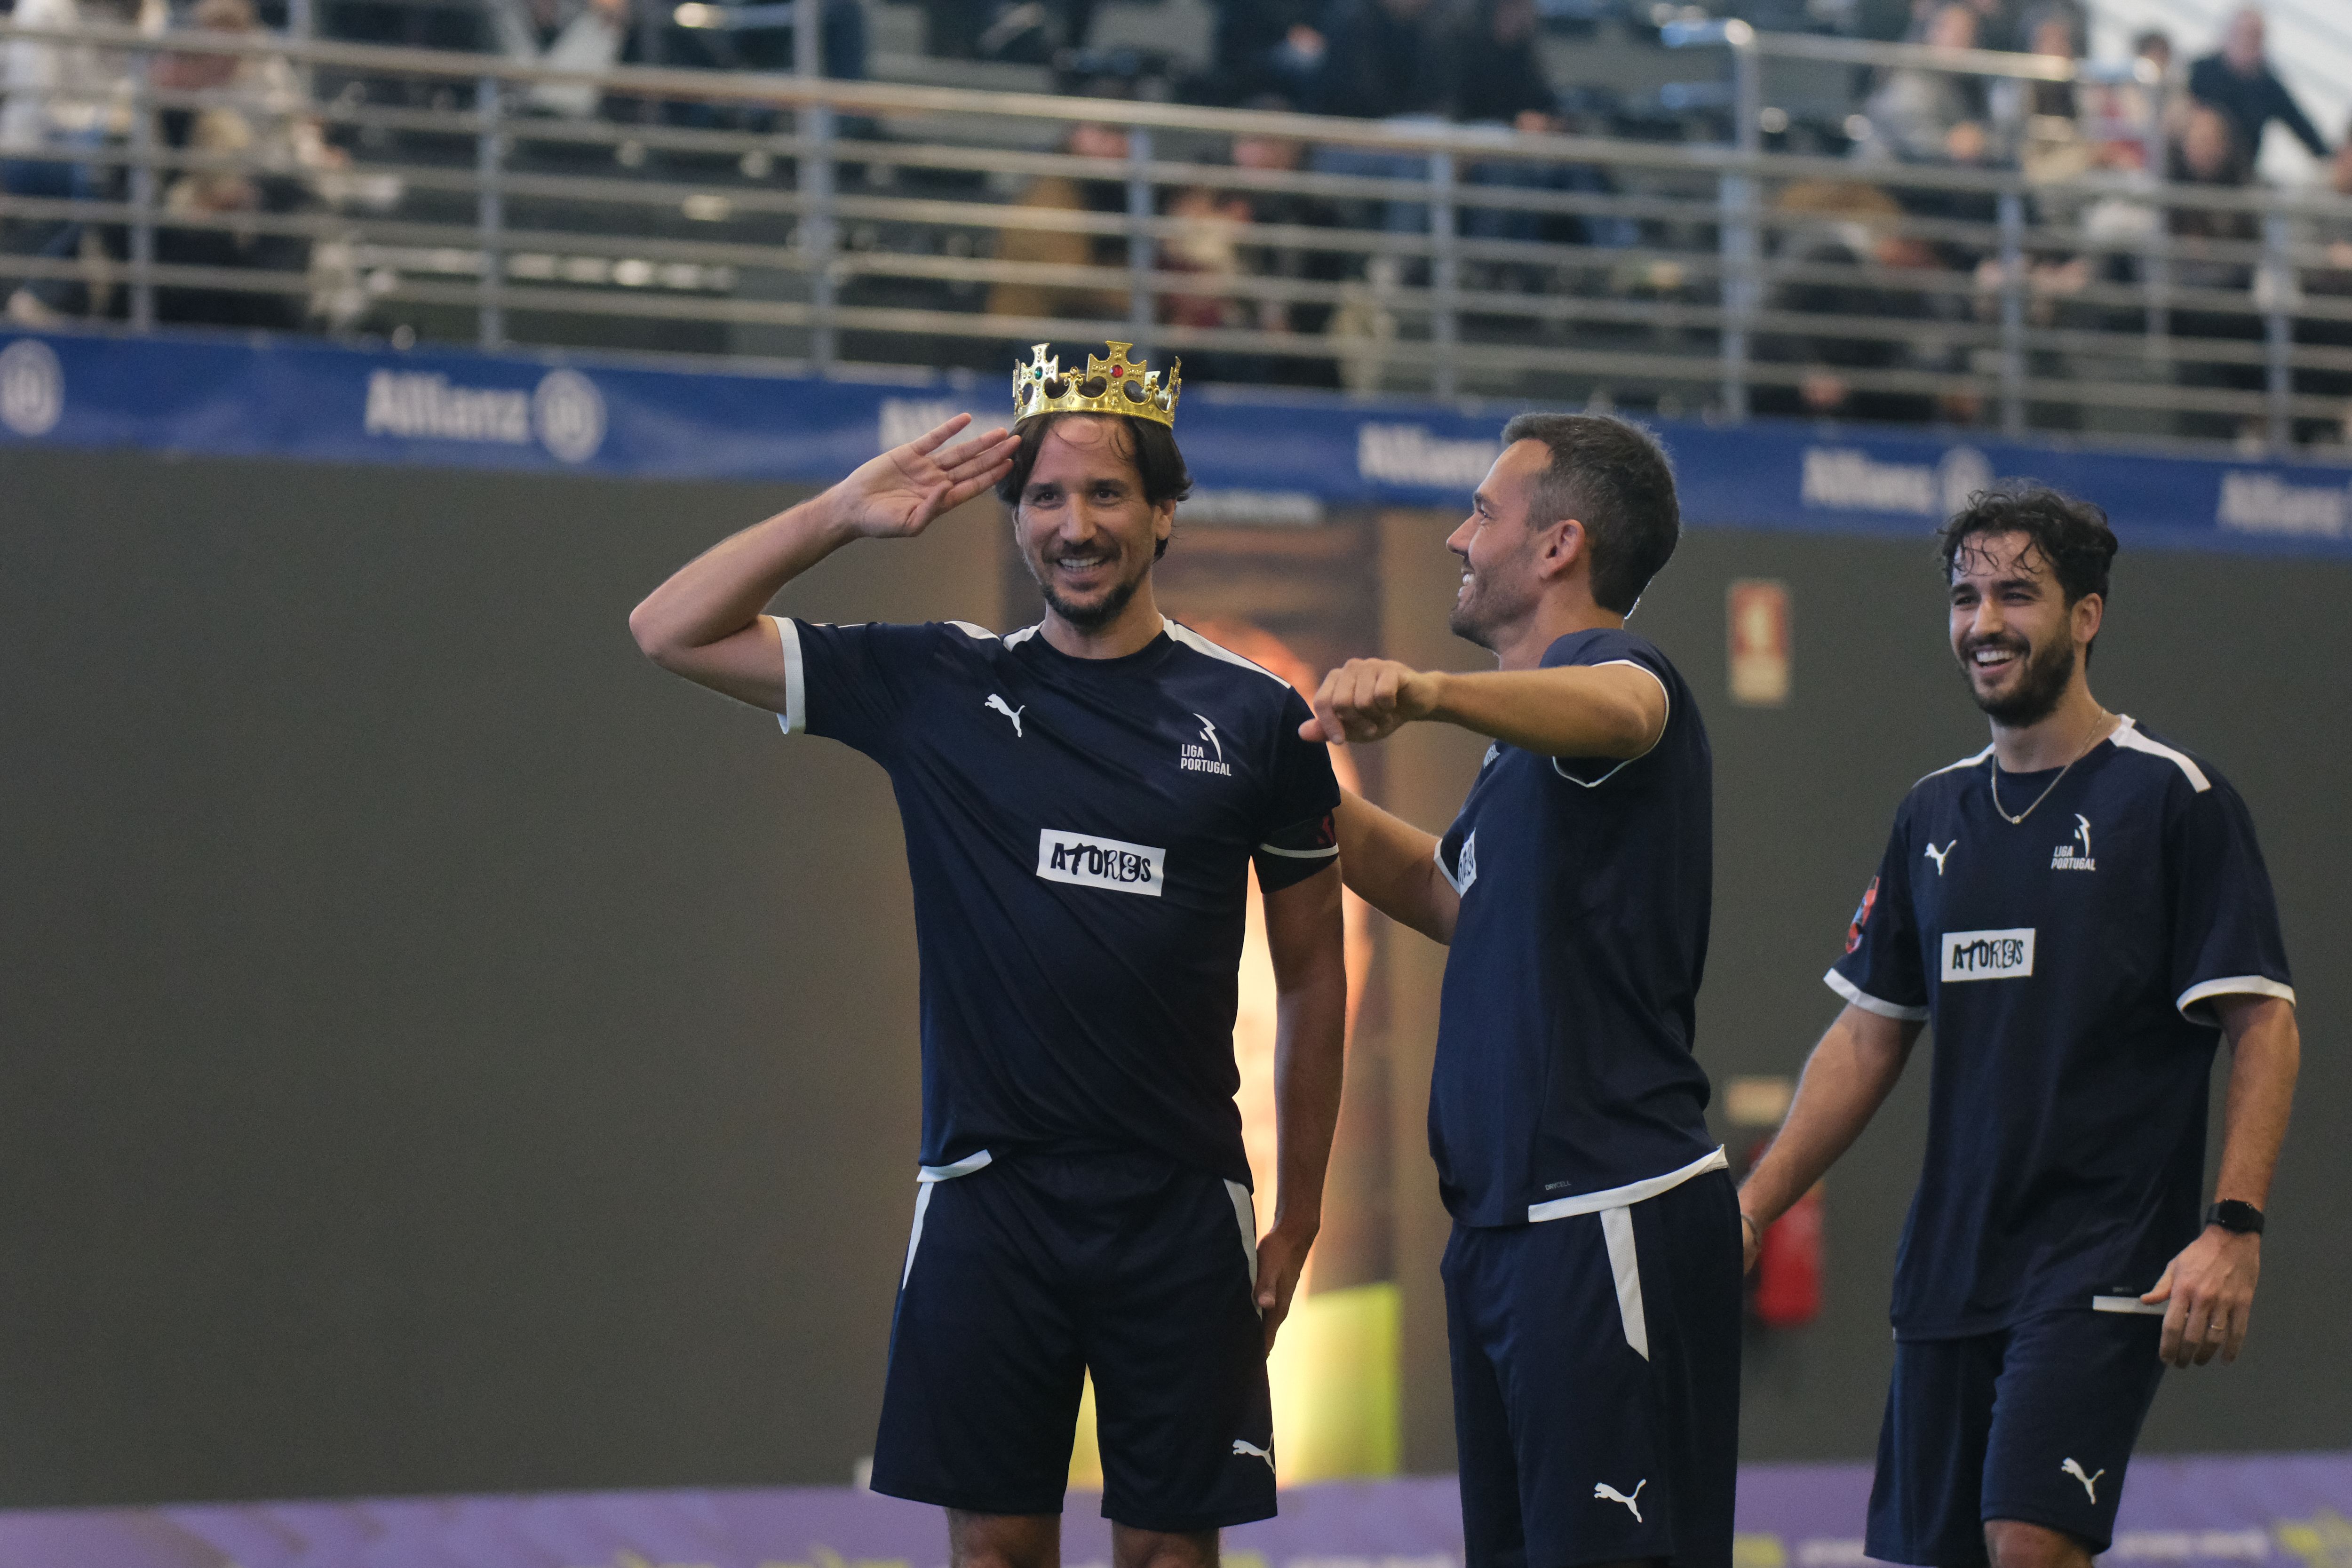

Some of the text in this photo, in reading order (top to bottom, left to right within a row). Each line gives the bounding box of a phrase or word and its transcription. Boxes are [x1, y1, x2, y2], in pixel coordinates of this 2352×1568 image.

[1181, 744, 1204, 758] LIGA
[1181, 758, 1232, 776] PORTUGAL
[2054, 845, 2074, 857] LIGA
[1050, 843, 1151, 883] ATORES
[2051, 858, 2096, 871] PORTUGAL
[1952, 939, 2023, 971] ATORES
